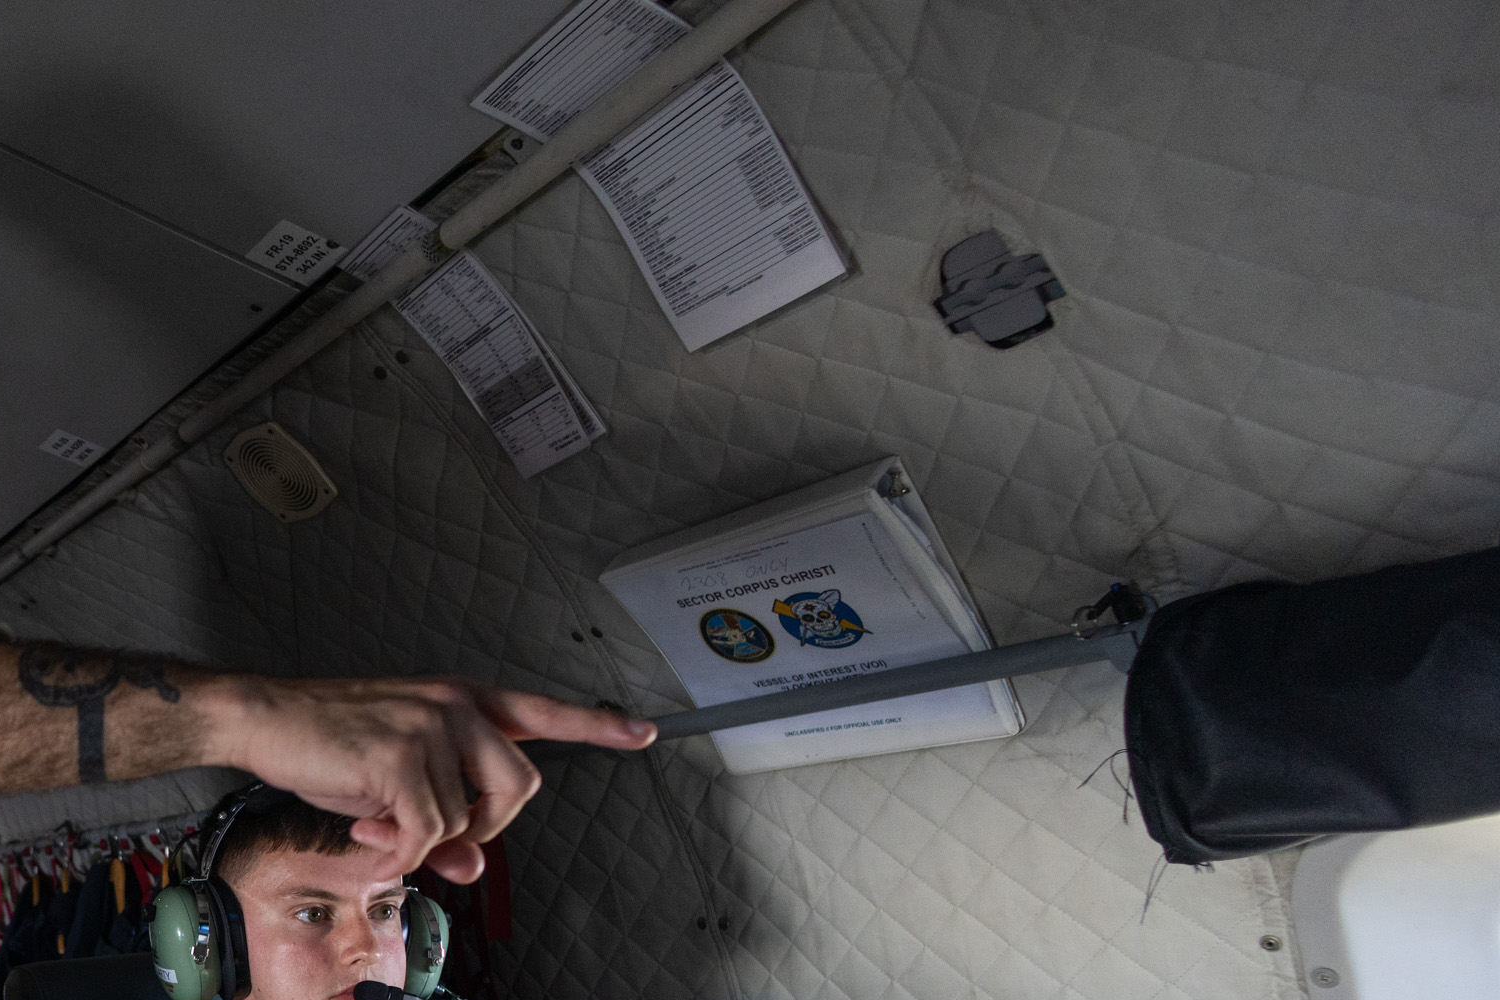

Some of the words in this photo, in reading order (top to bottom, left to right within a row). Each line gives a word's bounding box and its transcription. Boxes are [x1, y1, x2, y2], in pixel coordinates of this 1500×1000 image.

[265, 234, 294, 258] FR-19
[275, 235, 318, 271] STA-8692
[296, 259, 317, 275] 342
[745, 557, 788, 578] ONLY
[677, 591, 724, 608] SECTOR
[725, 578, 779, 598] CORPUS
[780, 565, 836, 585] CHRISTI
[753, 676, 792, 688] VESSEL
[792, 673, 805, 682] OF
[806, 664, 857, 680] INTEREST
[860, 659, 888, 672] (VOI)
[784, 726, 825, 737] UNCLASSIFIED
[843, 721, 870, 730] OFFICIAL
[885, 717, 902, 725] ONLY
